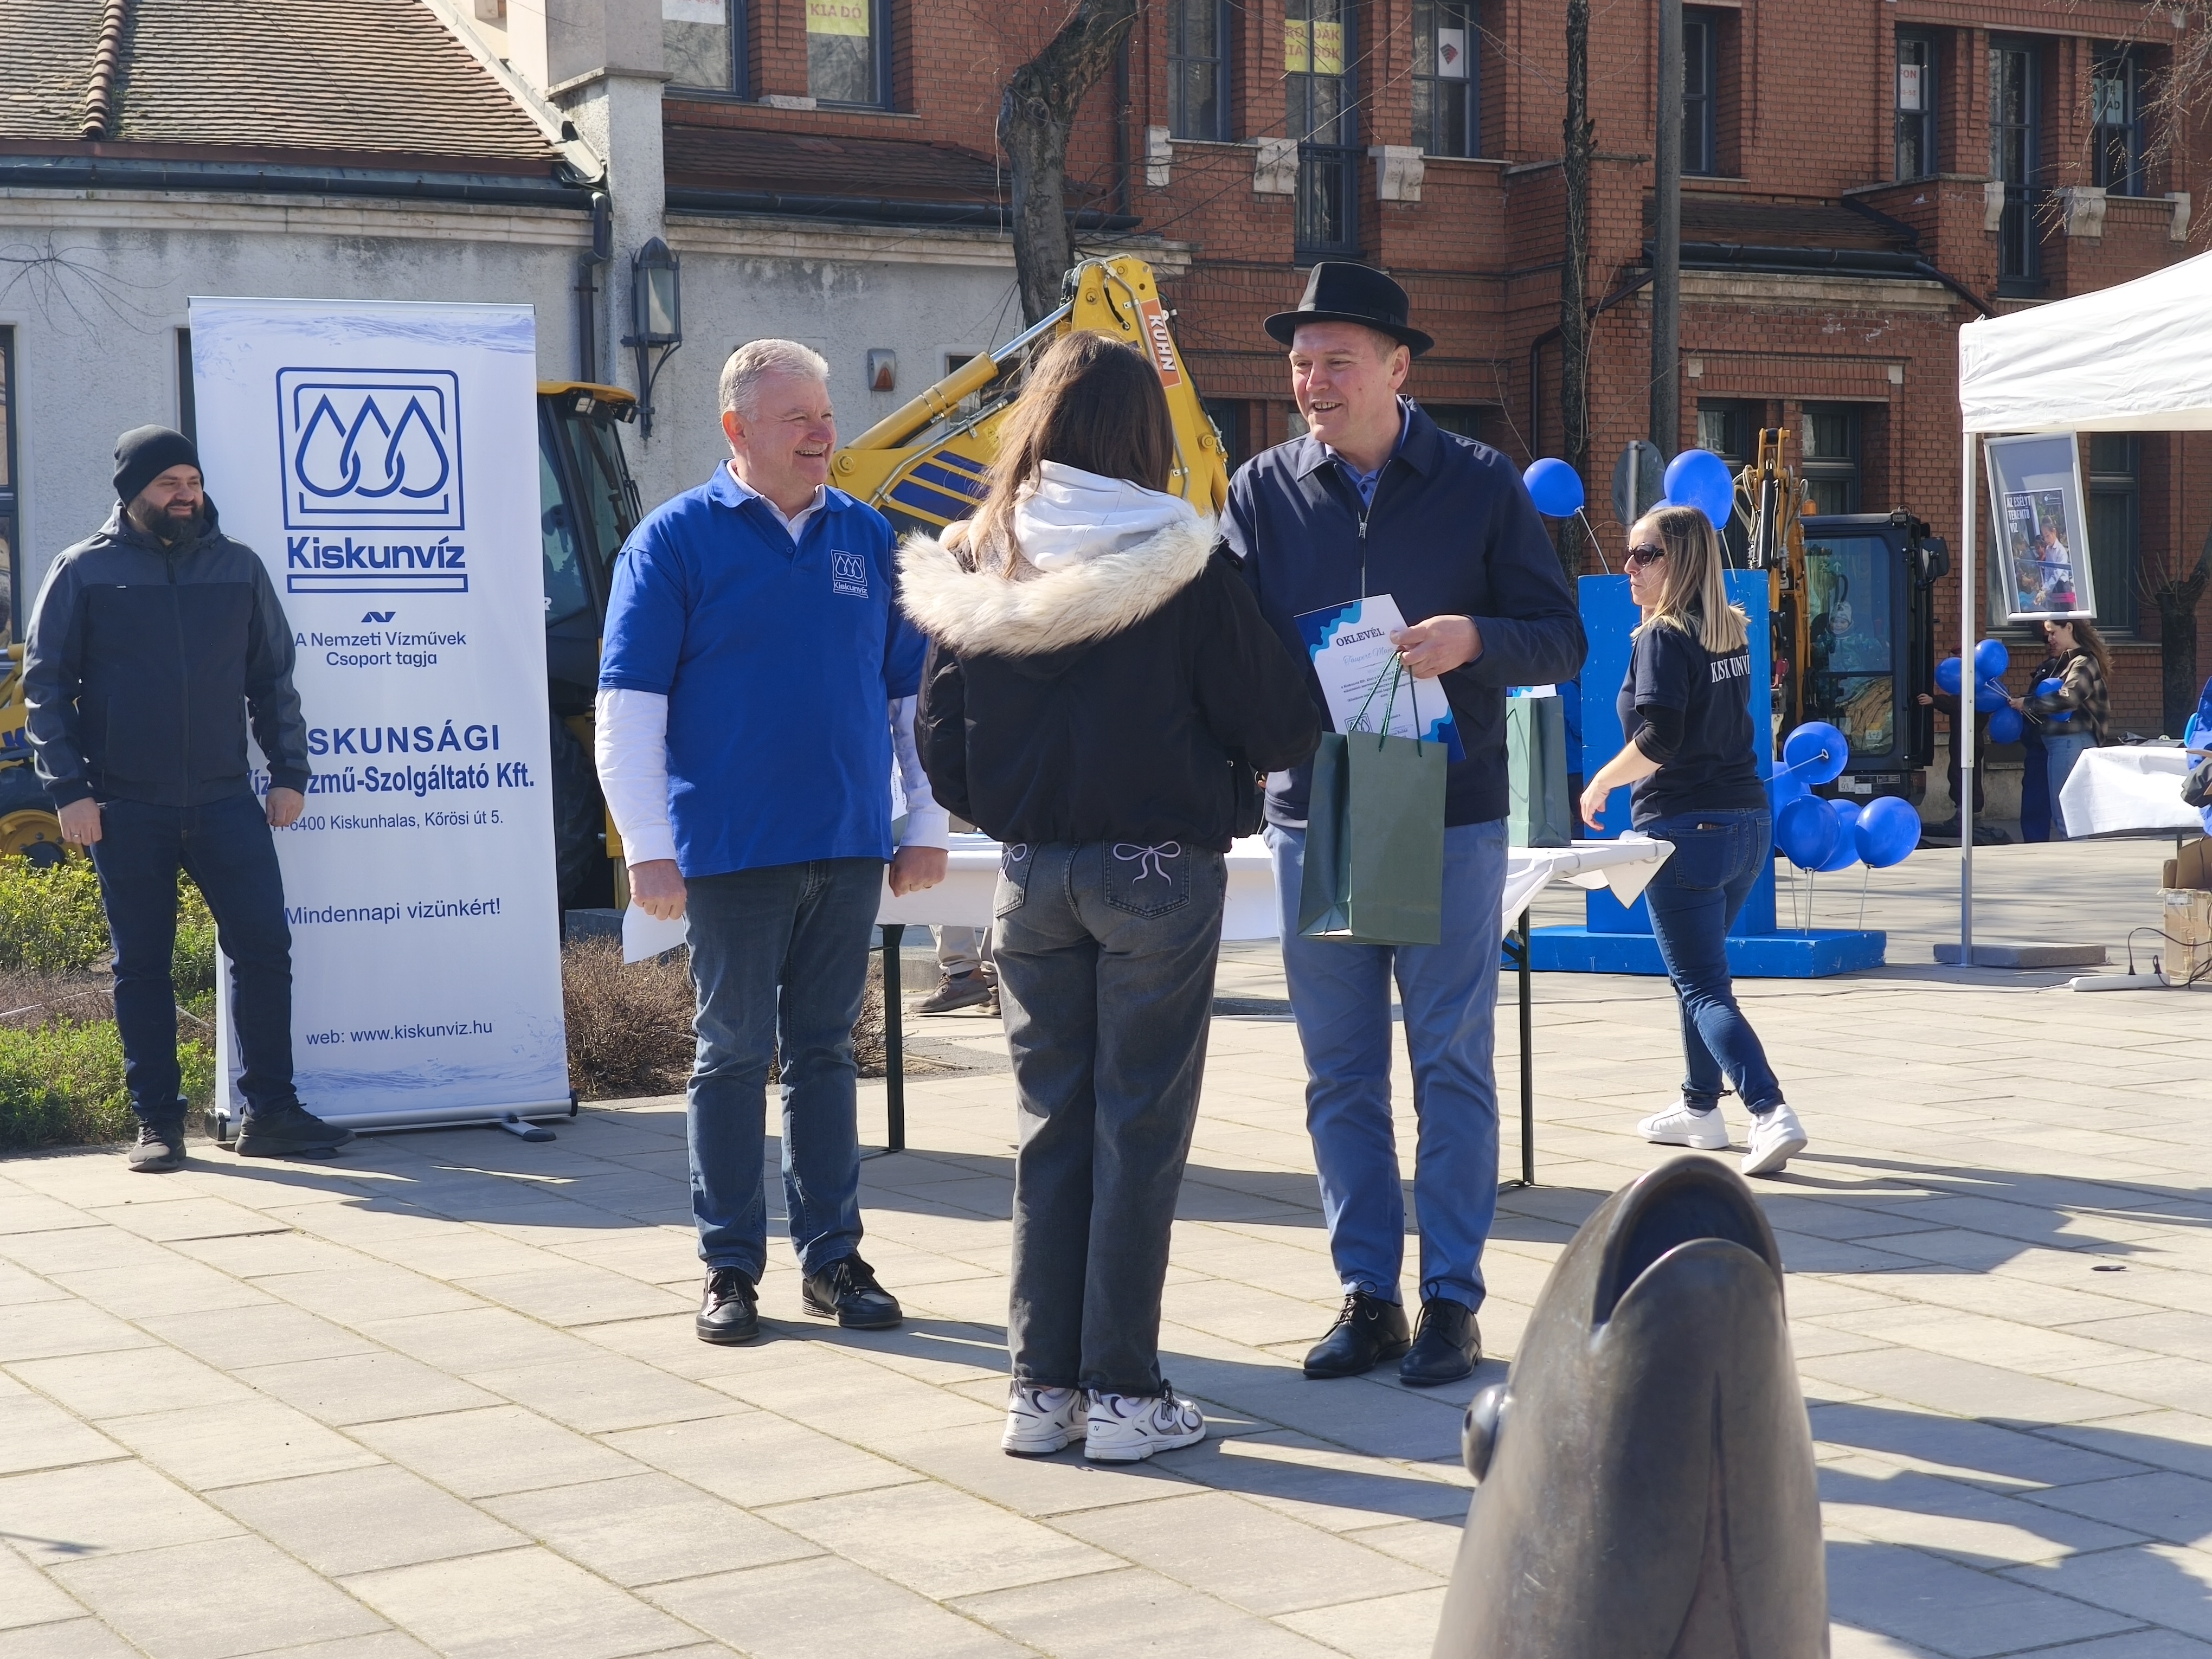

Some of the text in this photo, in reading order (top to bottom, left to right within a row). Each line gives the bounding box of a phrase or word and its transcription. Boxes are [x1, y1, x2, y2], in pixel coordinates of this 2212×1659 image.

[1148, 314, 1176, 371] KUHN
[2007, 494, 2030, 507] AZ ESÉLYT
[2009, 521, 2018, 533] VÍZ
[287, 536, 465, 569] Kiskunvíz
[833, 581, 867, 594] Kiskunvíz
[294, 631, 466, 647] A Nemzeti Vízművek
[1336, 627, 1385, 647] OKLEVÉL
[326, 651, 437, 668] Csoport tagja
[308, 719, 499, 755] SKUNSÁGI
[497, 762, 534, 788] Kft.
[331, 813, 420, 830] Kiskunhalas,
[425, 811, 469, 826] Kőrösi
[474, 811, 487, 825] út
[491, 811, 503, 824] 5.
[285, 898, 500, 924] Mindennapi vizünkért!
[306, 1020, 492, 1045] web: www.kiskunviz.hu
